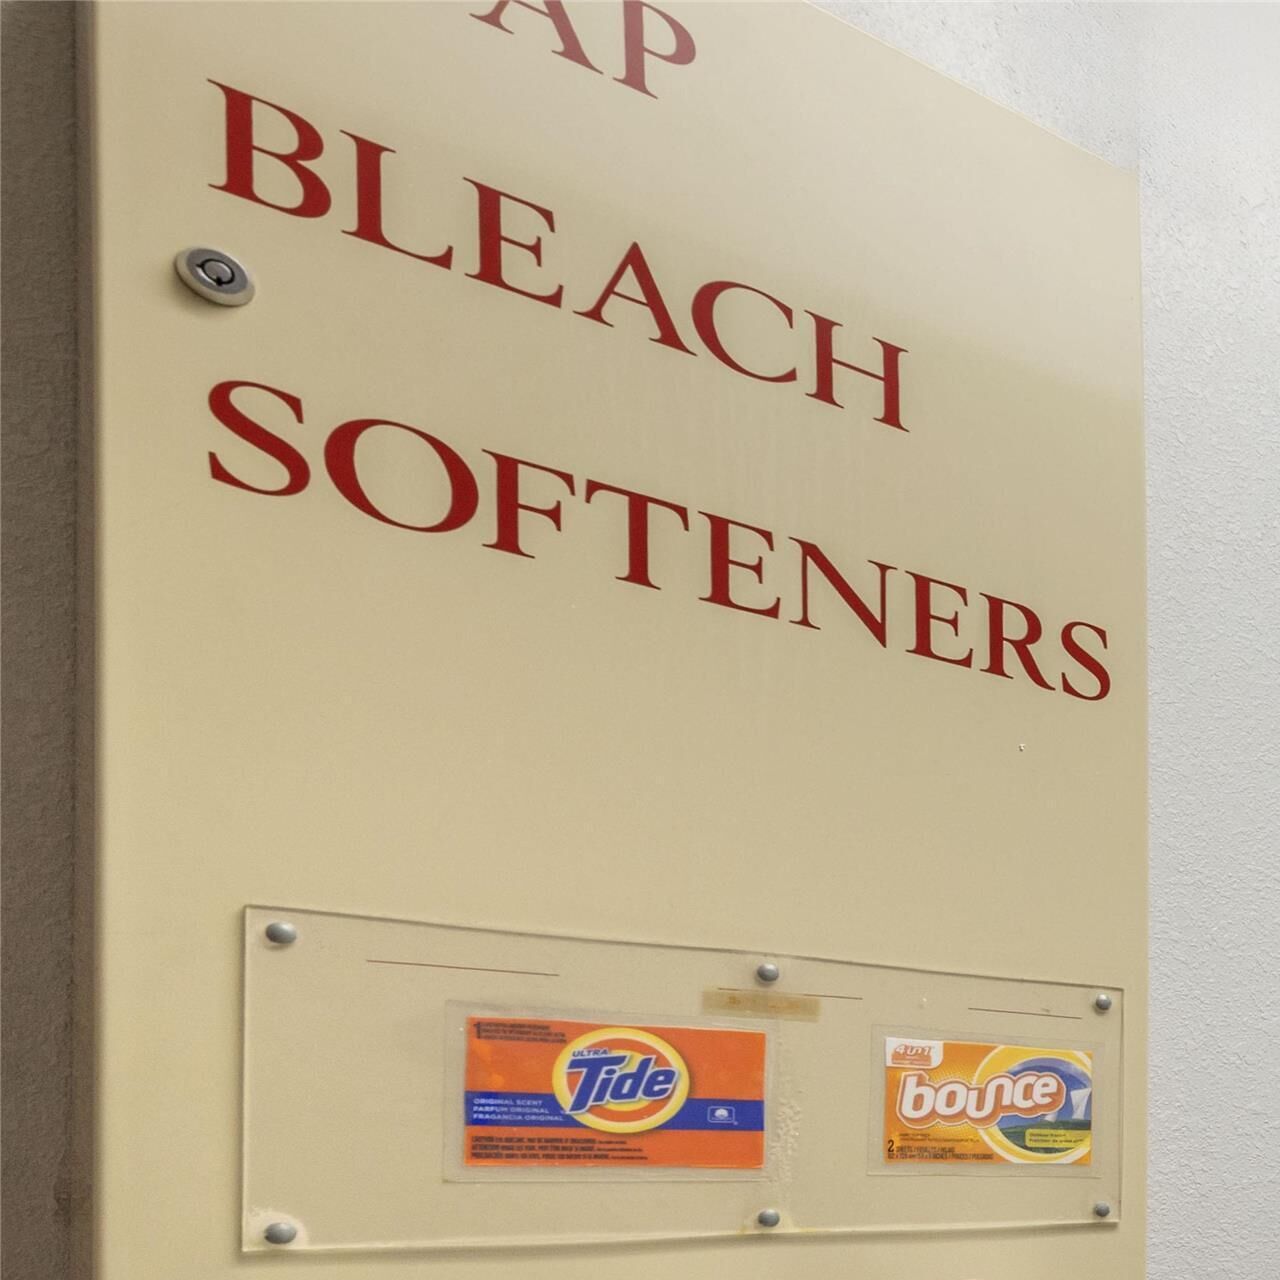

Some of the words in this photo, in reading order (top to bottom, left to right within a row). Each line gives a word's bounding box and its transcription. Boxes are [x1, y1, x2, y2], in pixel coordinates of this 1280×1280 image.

[207, 79, 910, 432] BLEACH
[207, 379, 1111, 701] SOFTENERS
[572, 1048, 609, 1057] ULTRA
[566, 1055, 678, 1114] Tide
[899, 1072, 1061, 1122] bounce
